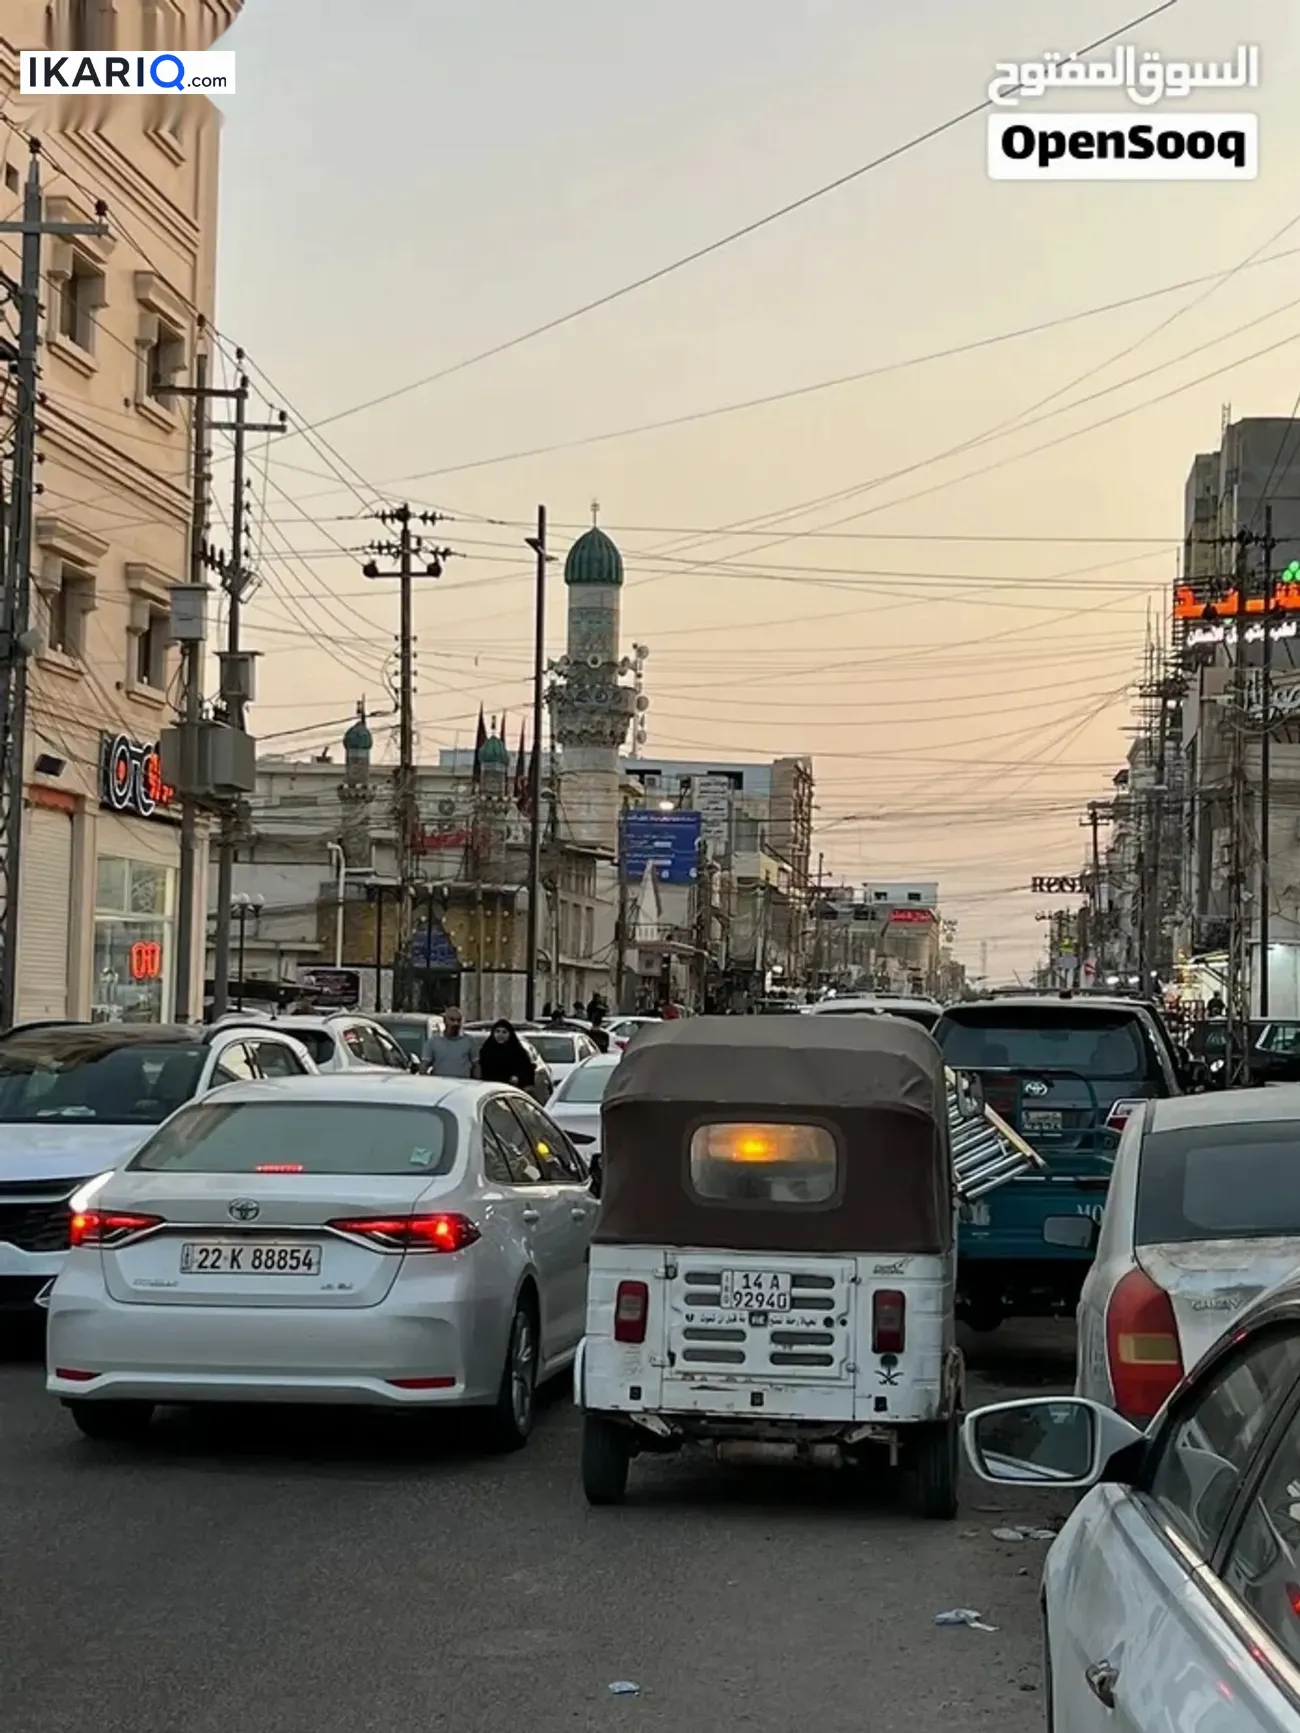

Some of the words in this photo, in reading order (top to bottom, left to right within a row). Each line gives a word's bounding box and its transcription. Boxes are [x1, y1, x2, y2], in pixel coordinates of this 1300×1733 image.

[198, 1248, 222, 1270] 22
[230, 1248, 243, 1270] K
[251, 1248, 314, 1271] 88854
[742, 1273, 762, 1289] 14
[770, 1273, 780, 1290] A
[733, 1291, 787, 1309] 92940
